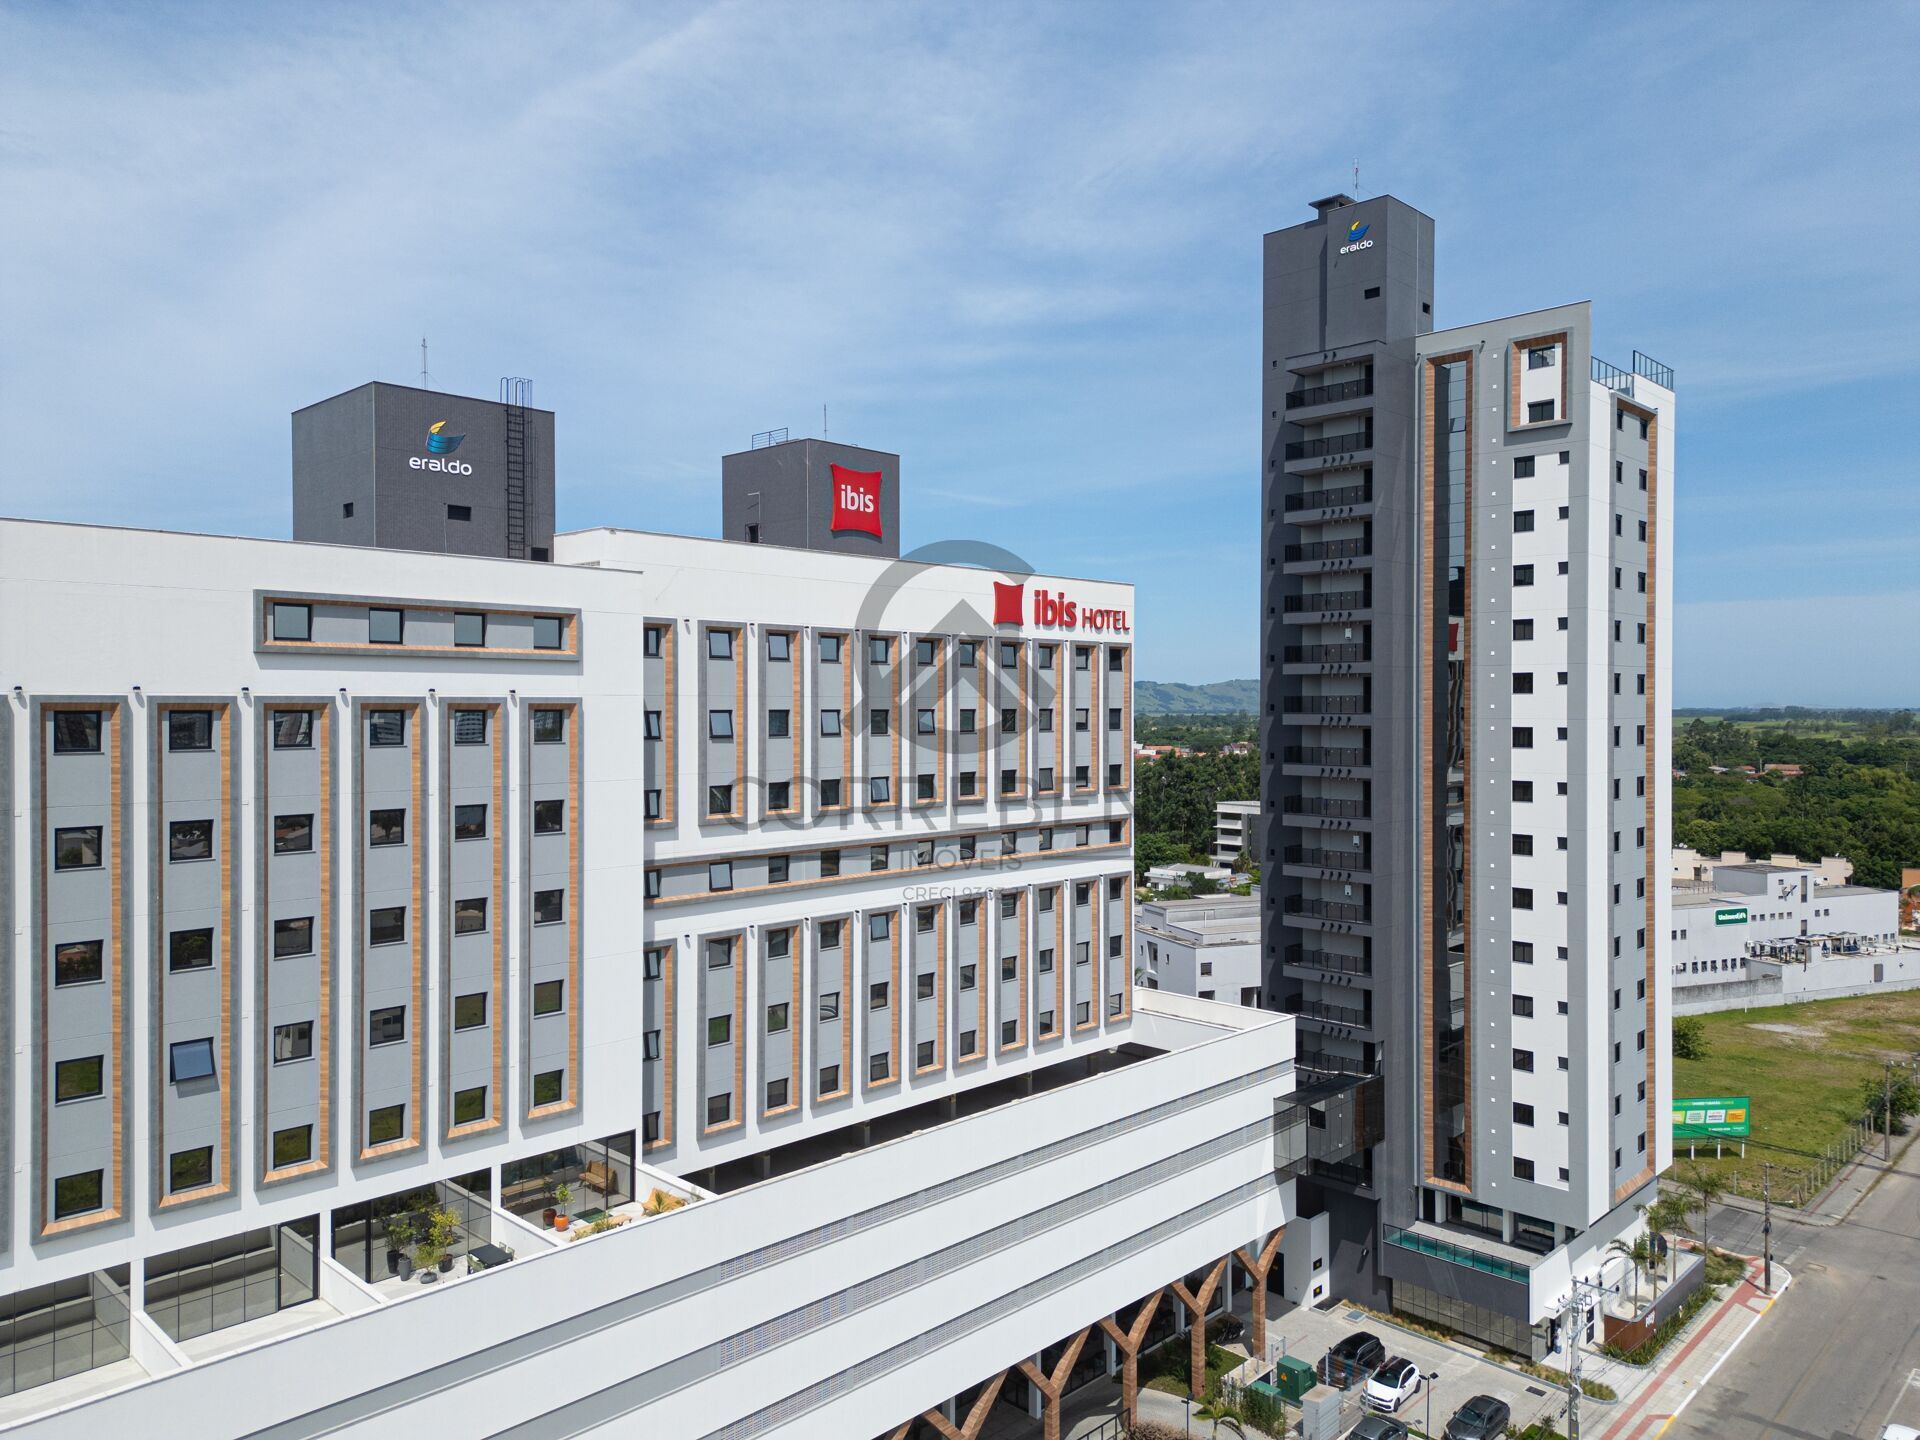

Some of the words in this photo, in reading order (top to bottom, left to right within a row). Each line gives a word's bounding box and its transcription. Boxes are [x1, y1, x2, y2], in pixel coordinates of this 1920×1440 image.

[1340, 240, 1373, 254] eraldo
[409, 457, 472, 475] eraldo
[841, 484, 874, 513] ibis
[1034, 590, 1077, 627] ibis
[1082, 608, 1130, 630] HOTEL
